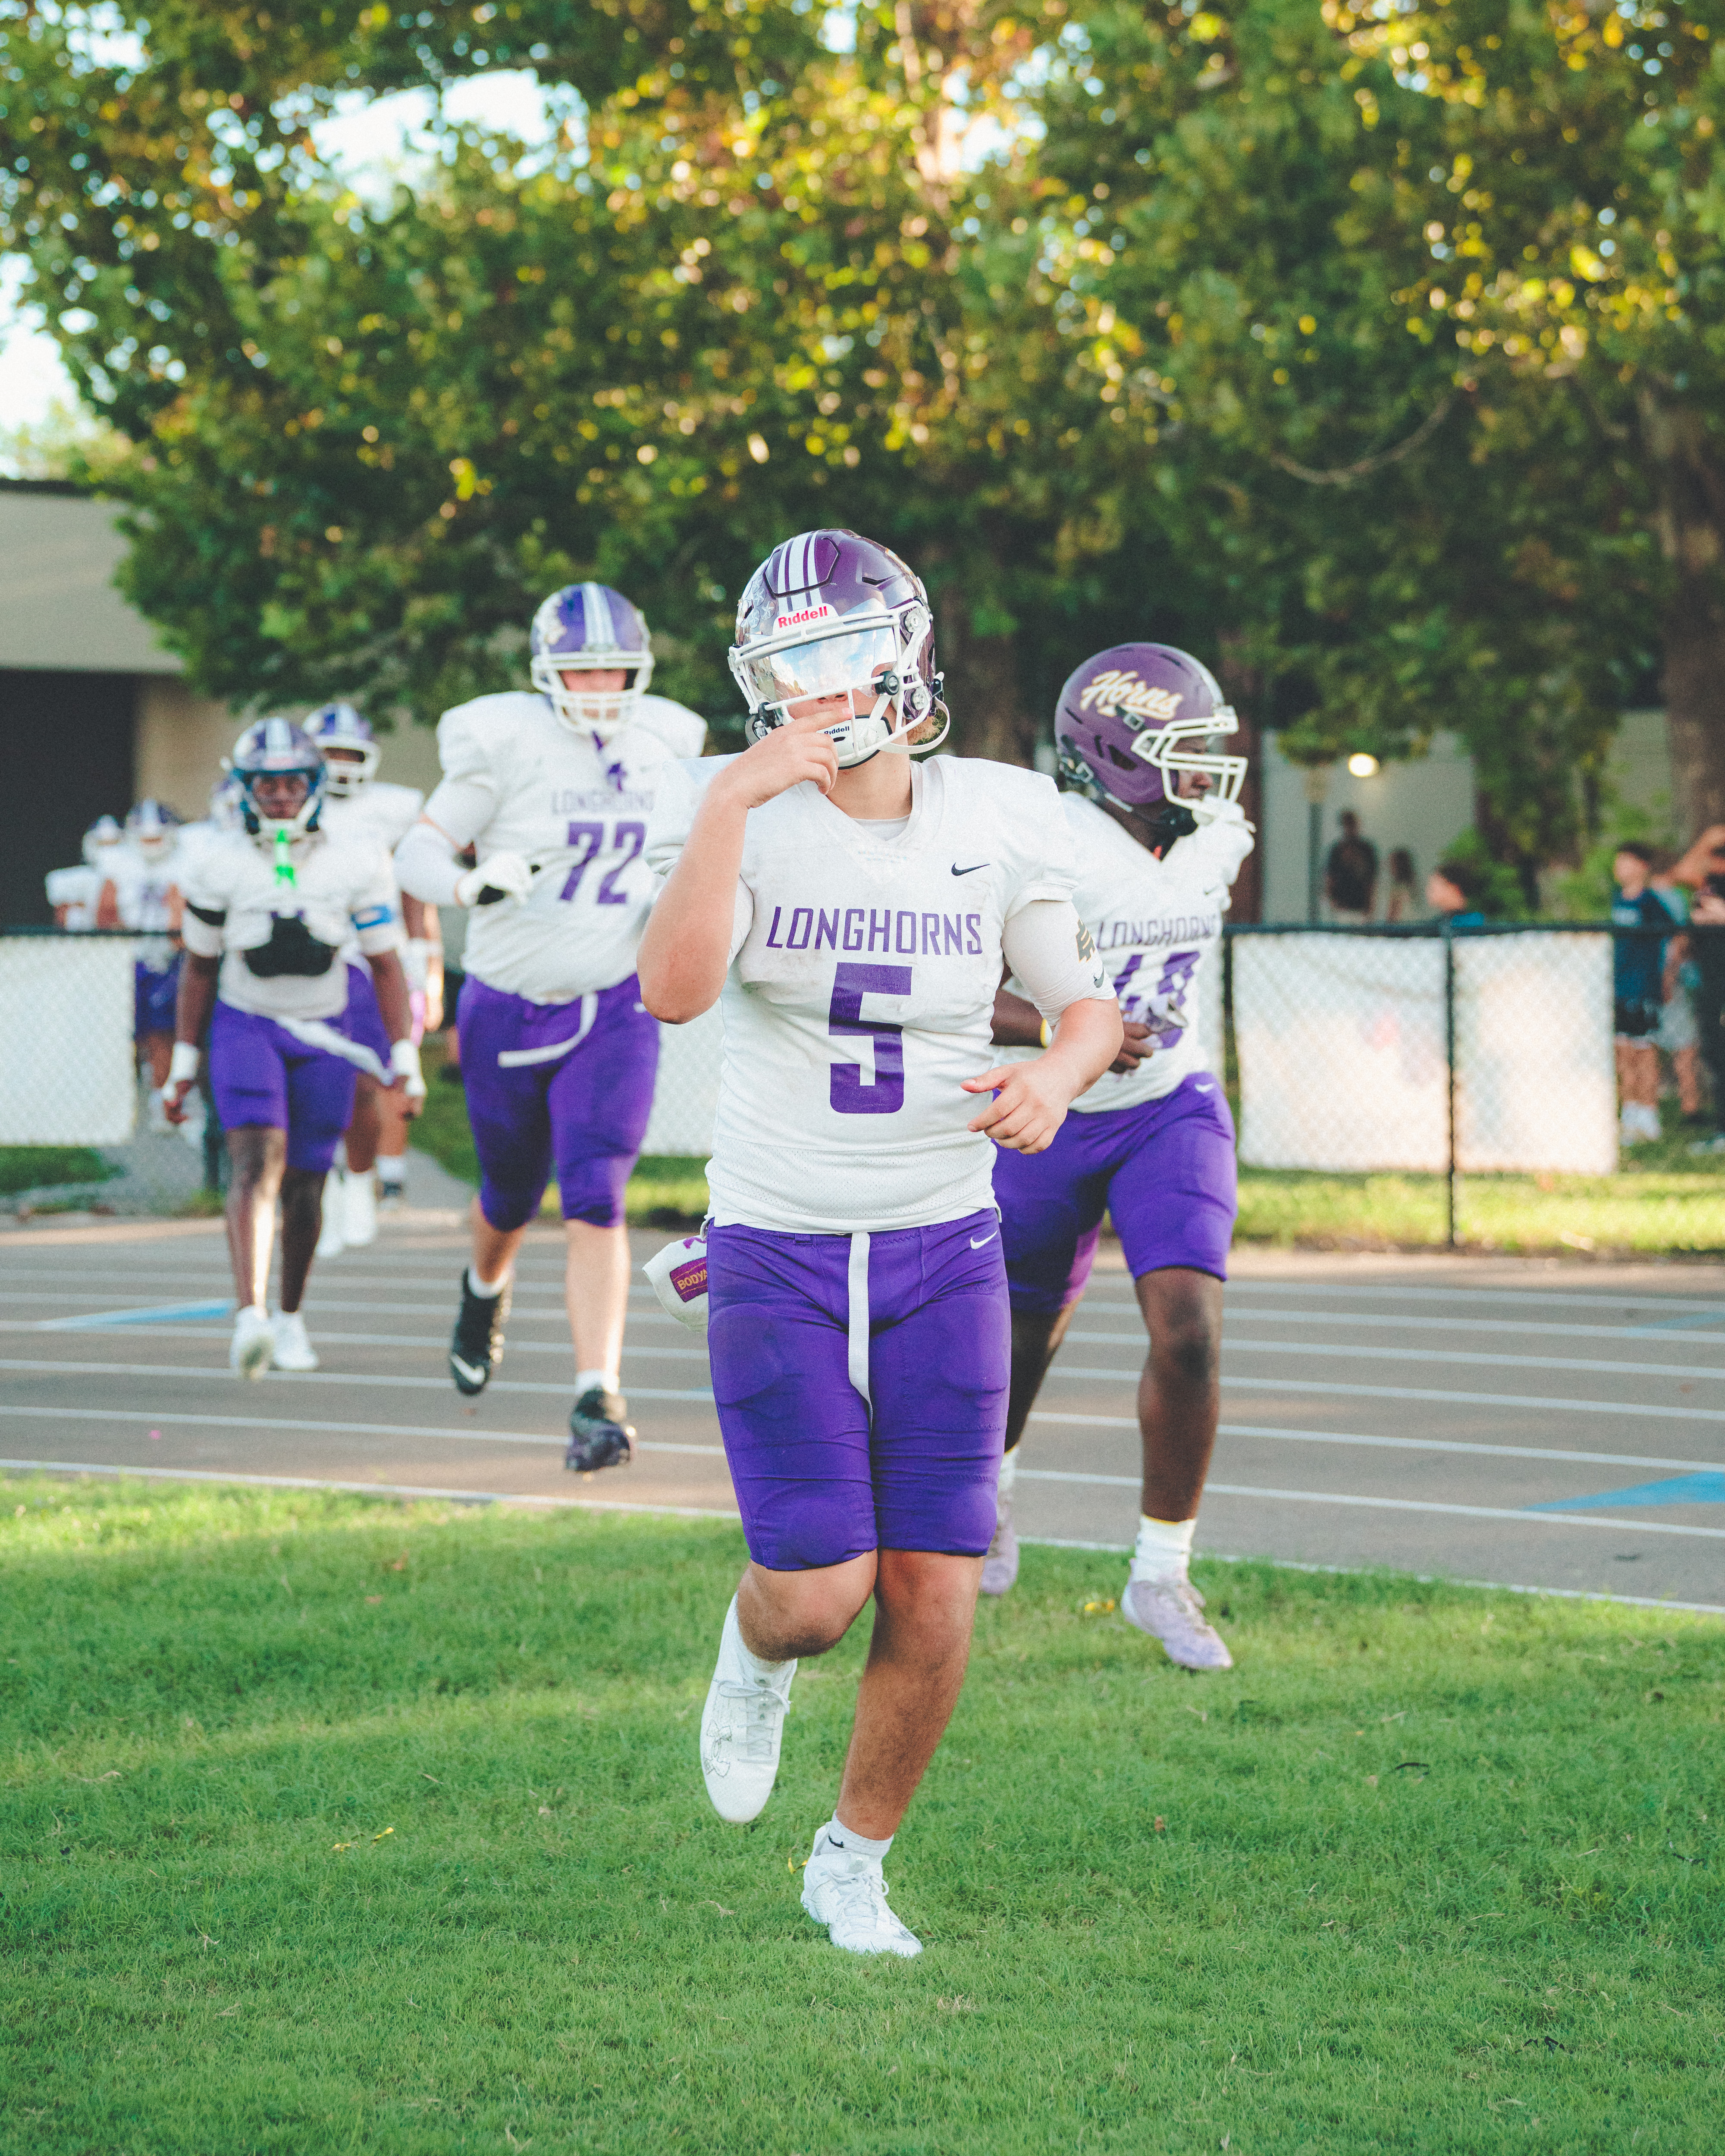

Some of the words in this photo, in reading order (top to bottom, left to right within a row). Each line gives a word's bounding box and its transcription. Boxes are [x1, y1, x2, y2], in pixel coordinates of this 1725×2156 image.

[778, 606, 828, 628] Riddell
[1080, 670, 1183, 720] Horns
[560, 821, 645, 905] 72
[765, 906, 983, 956] LONGHORNS
[828, 962, 913, 1114] 5
